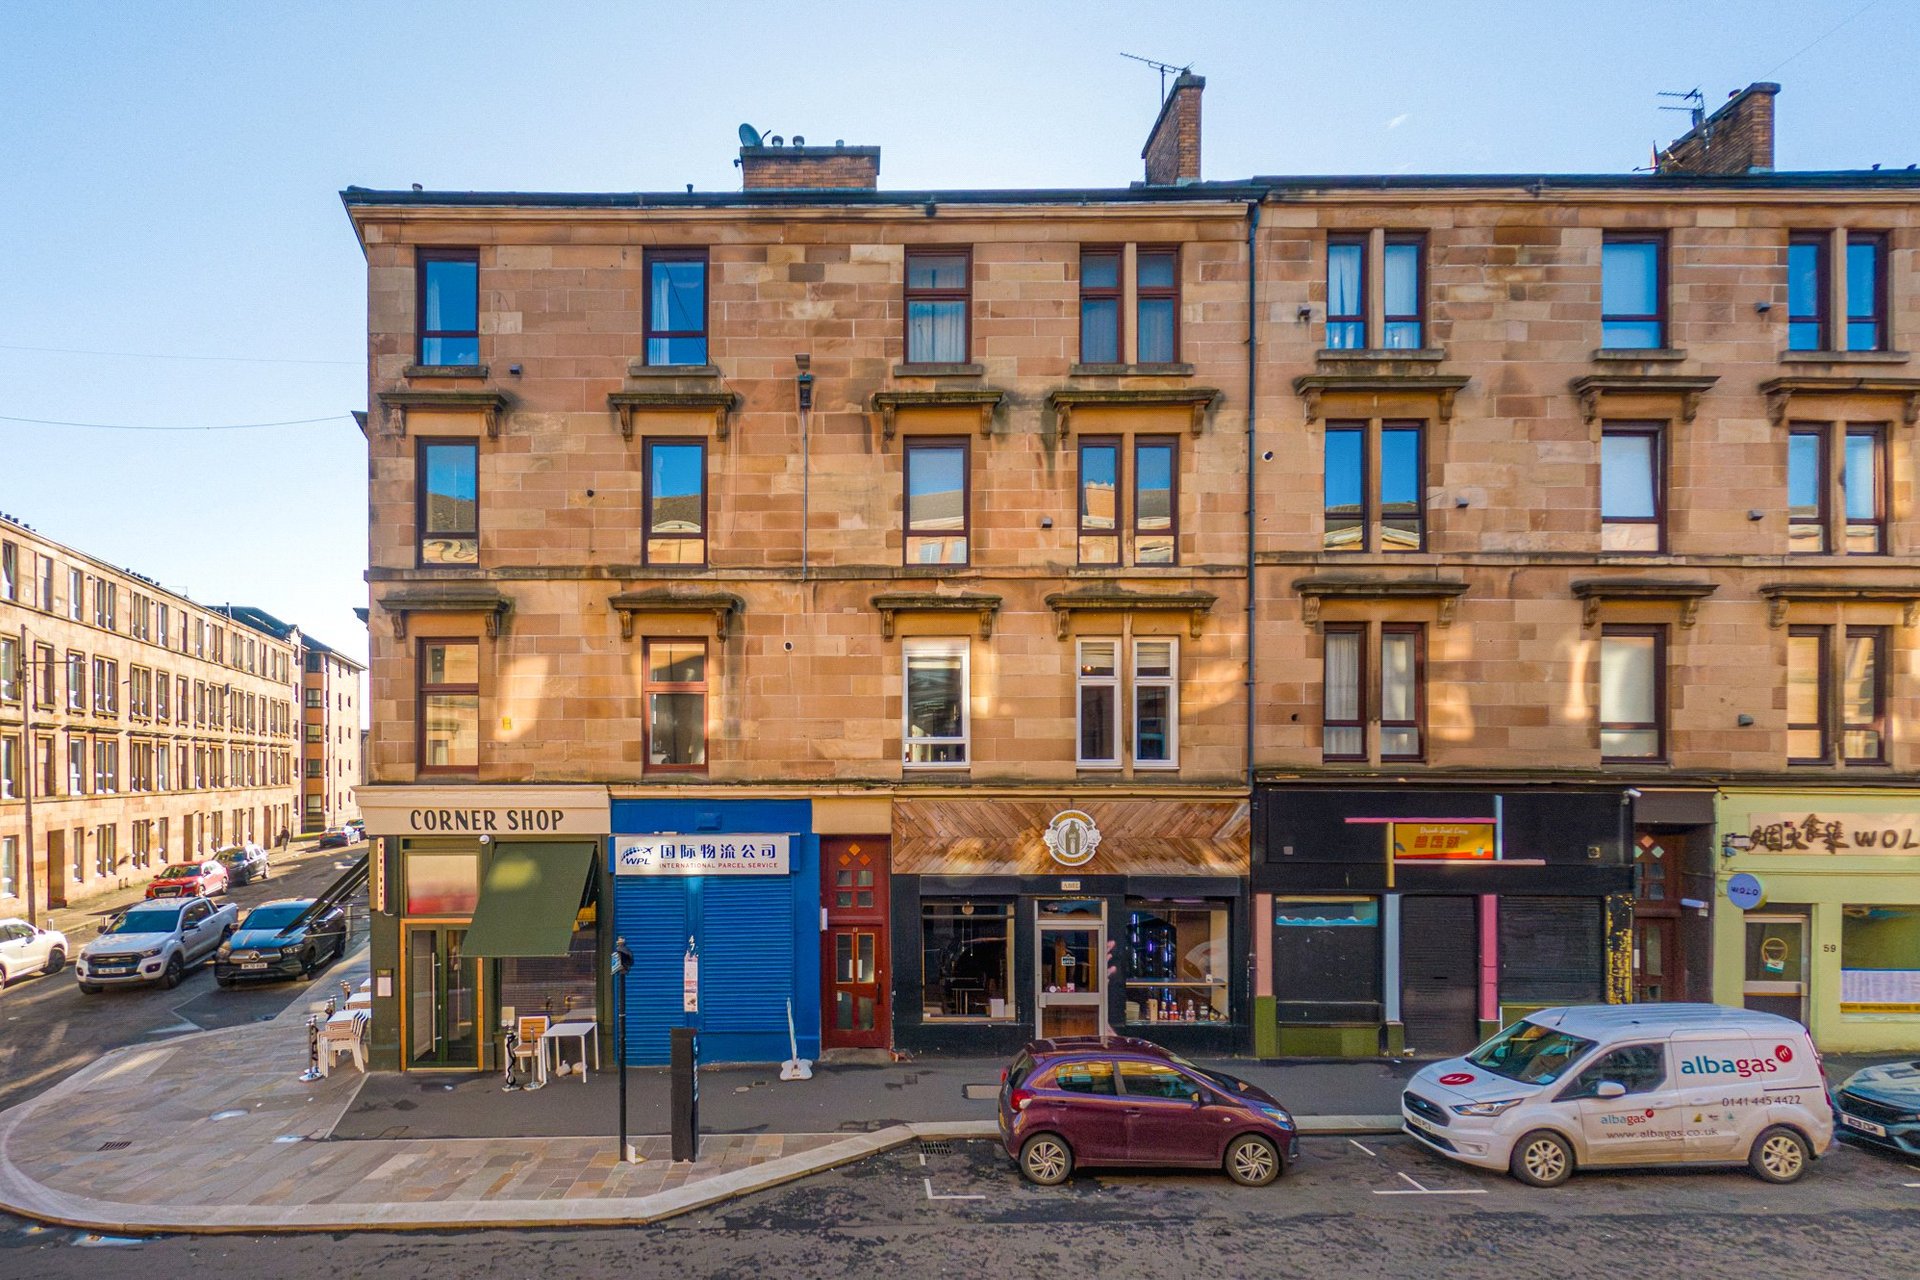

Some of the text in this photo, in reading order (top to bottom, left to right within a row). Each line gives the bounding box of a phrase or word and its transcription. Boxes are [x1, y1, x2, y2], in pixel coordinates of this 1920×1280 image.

[410, 809, 564, 831] CORNER SHOP
[660, 844, 776, 859] 国际物流公司
[625, 858, 651, 866] WPL
[1731, 886, 1759, 896] WOLO
[1823, 945, 1837, 953] 59
[1681, 1056, 1778, 1078] albagas
[1722, 1095, 1801, 1107] 0141 445 4422
[1600, 1115, 1646, 1126] albagas
[1606, 1128, 1719, 1139] www.albagas.co.uk
